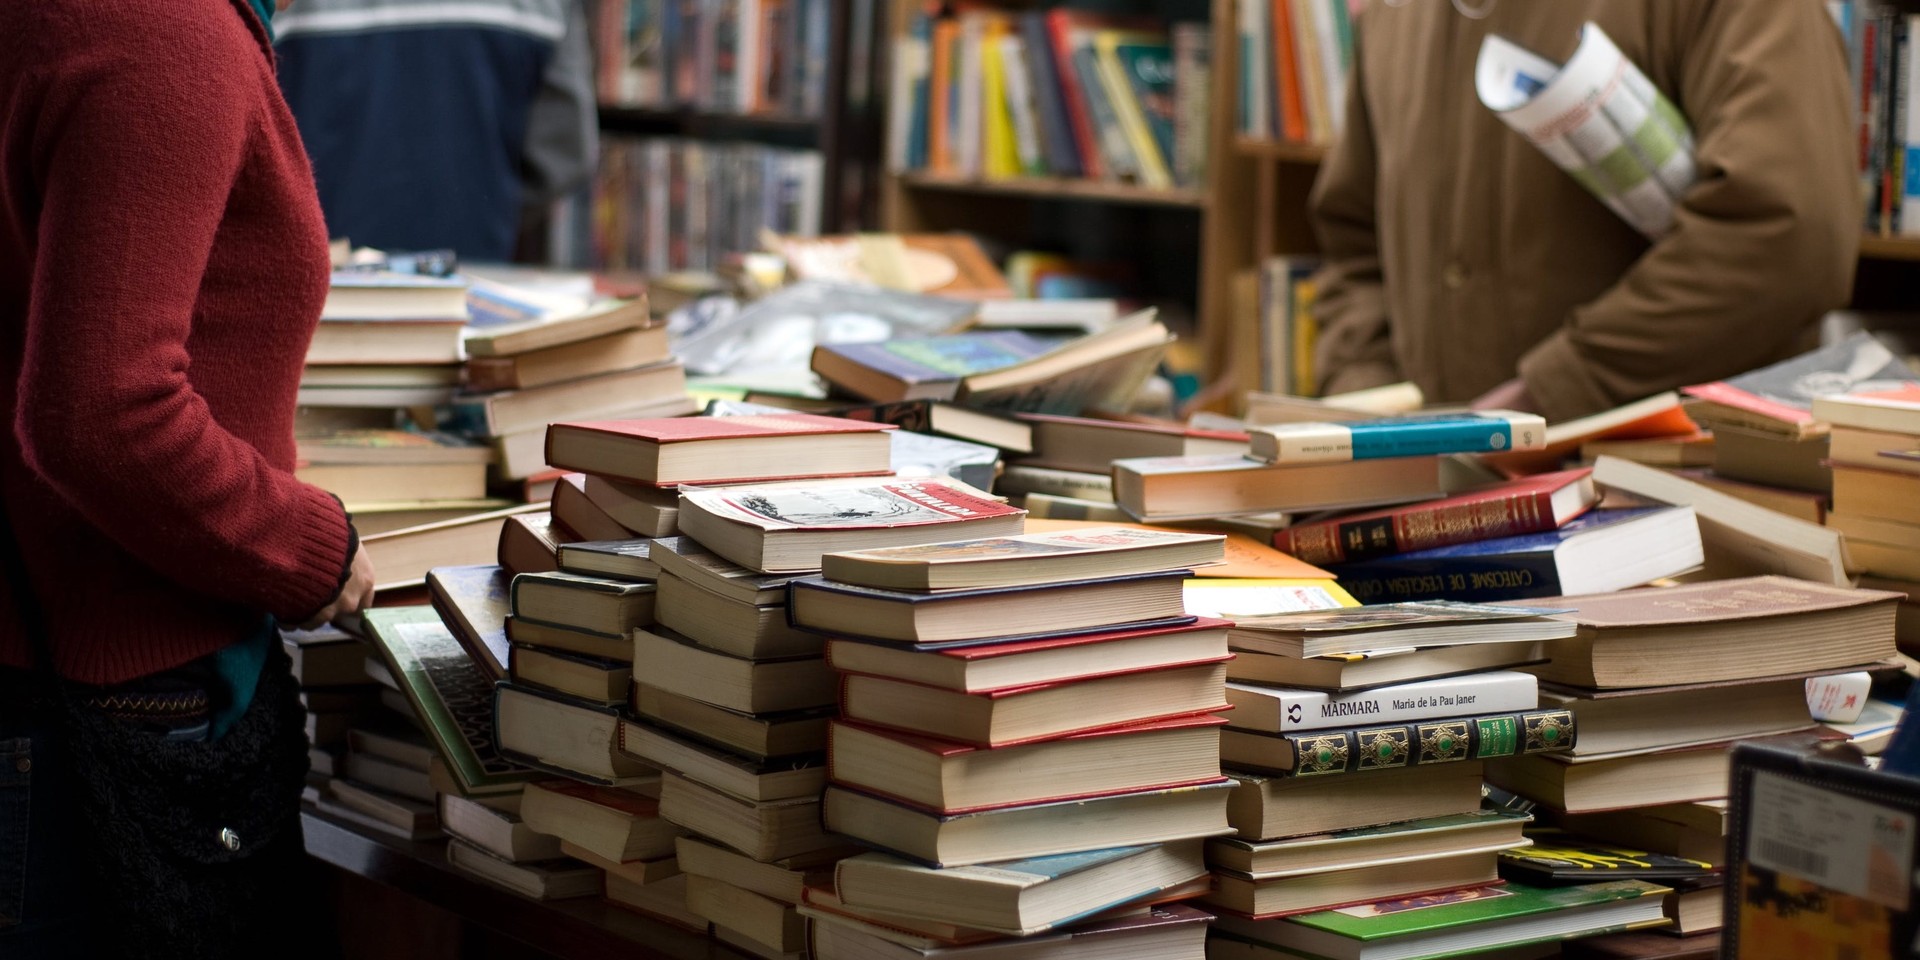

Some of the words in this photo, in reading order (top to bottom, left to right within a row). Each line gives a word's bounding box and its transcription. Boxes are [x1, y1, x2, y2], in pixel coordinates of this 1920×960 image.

[1448, 574, 1466, 590] DE
[1470, 569, 1532, 589] CATECISME
[1321, 700, 1380, 718] MÀRMARA
[1392, 698, 1415, 710] Maria
[1417, 697, 1428, 708] de
[1429, 696, 1437, 707] la
[1439, 696, 1454, 706] Pau
[1456, 694, 1476, 706] Janer
